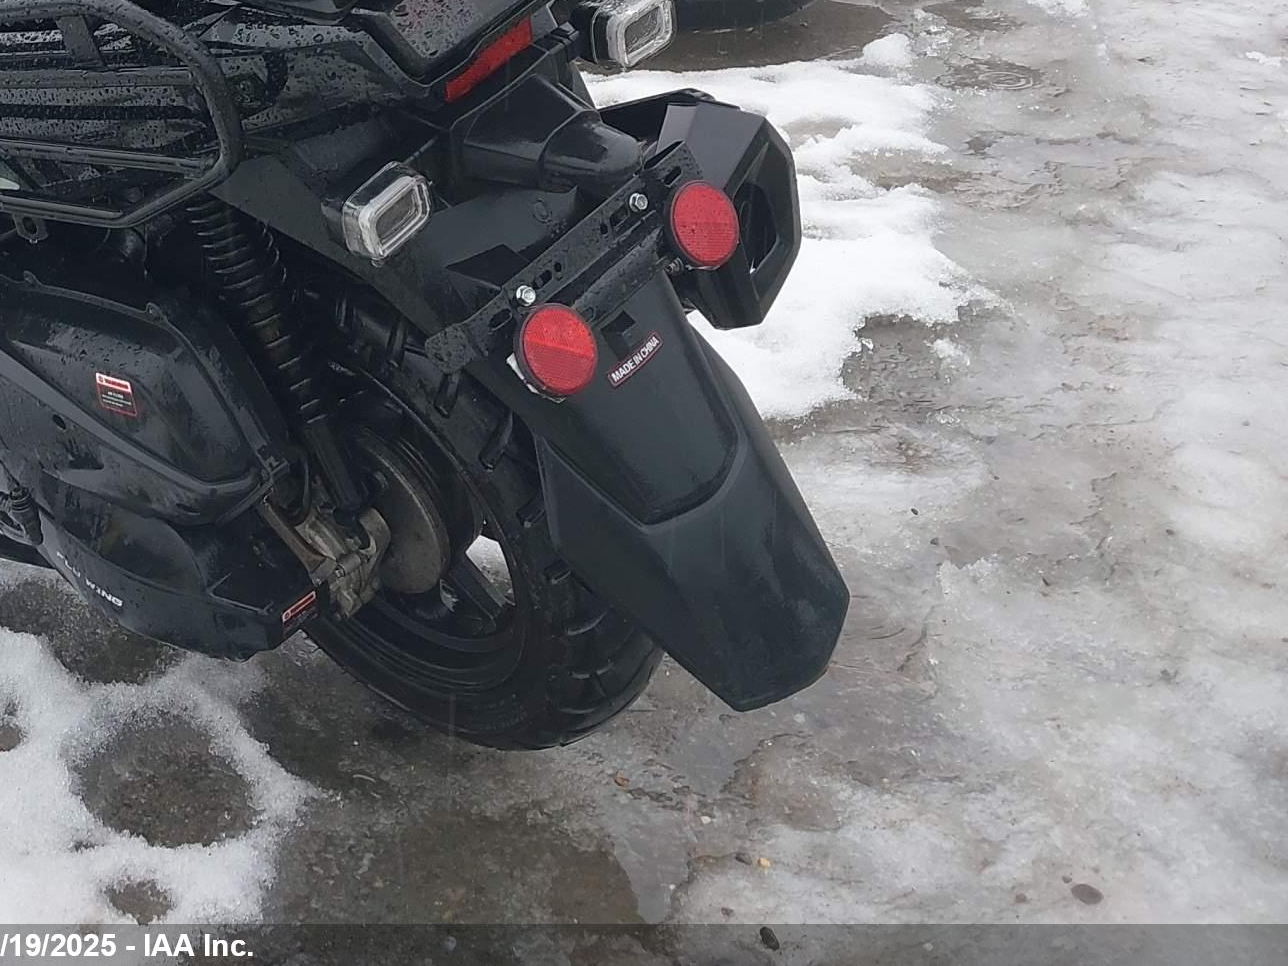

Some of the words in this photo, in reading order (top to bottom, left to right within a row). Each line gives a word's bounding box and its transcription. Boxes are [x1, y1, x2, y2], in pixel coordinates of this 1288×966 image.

[611, 358, 637, 382] MADE
[632, 352, 643, 365] IN
[640, 336, 660, 358] CHINA
